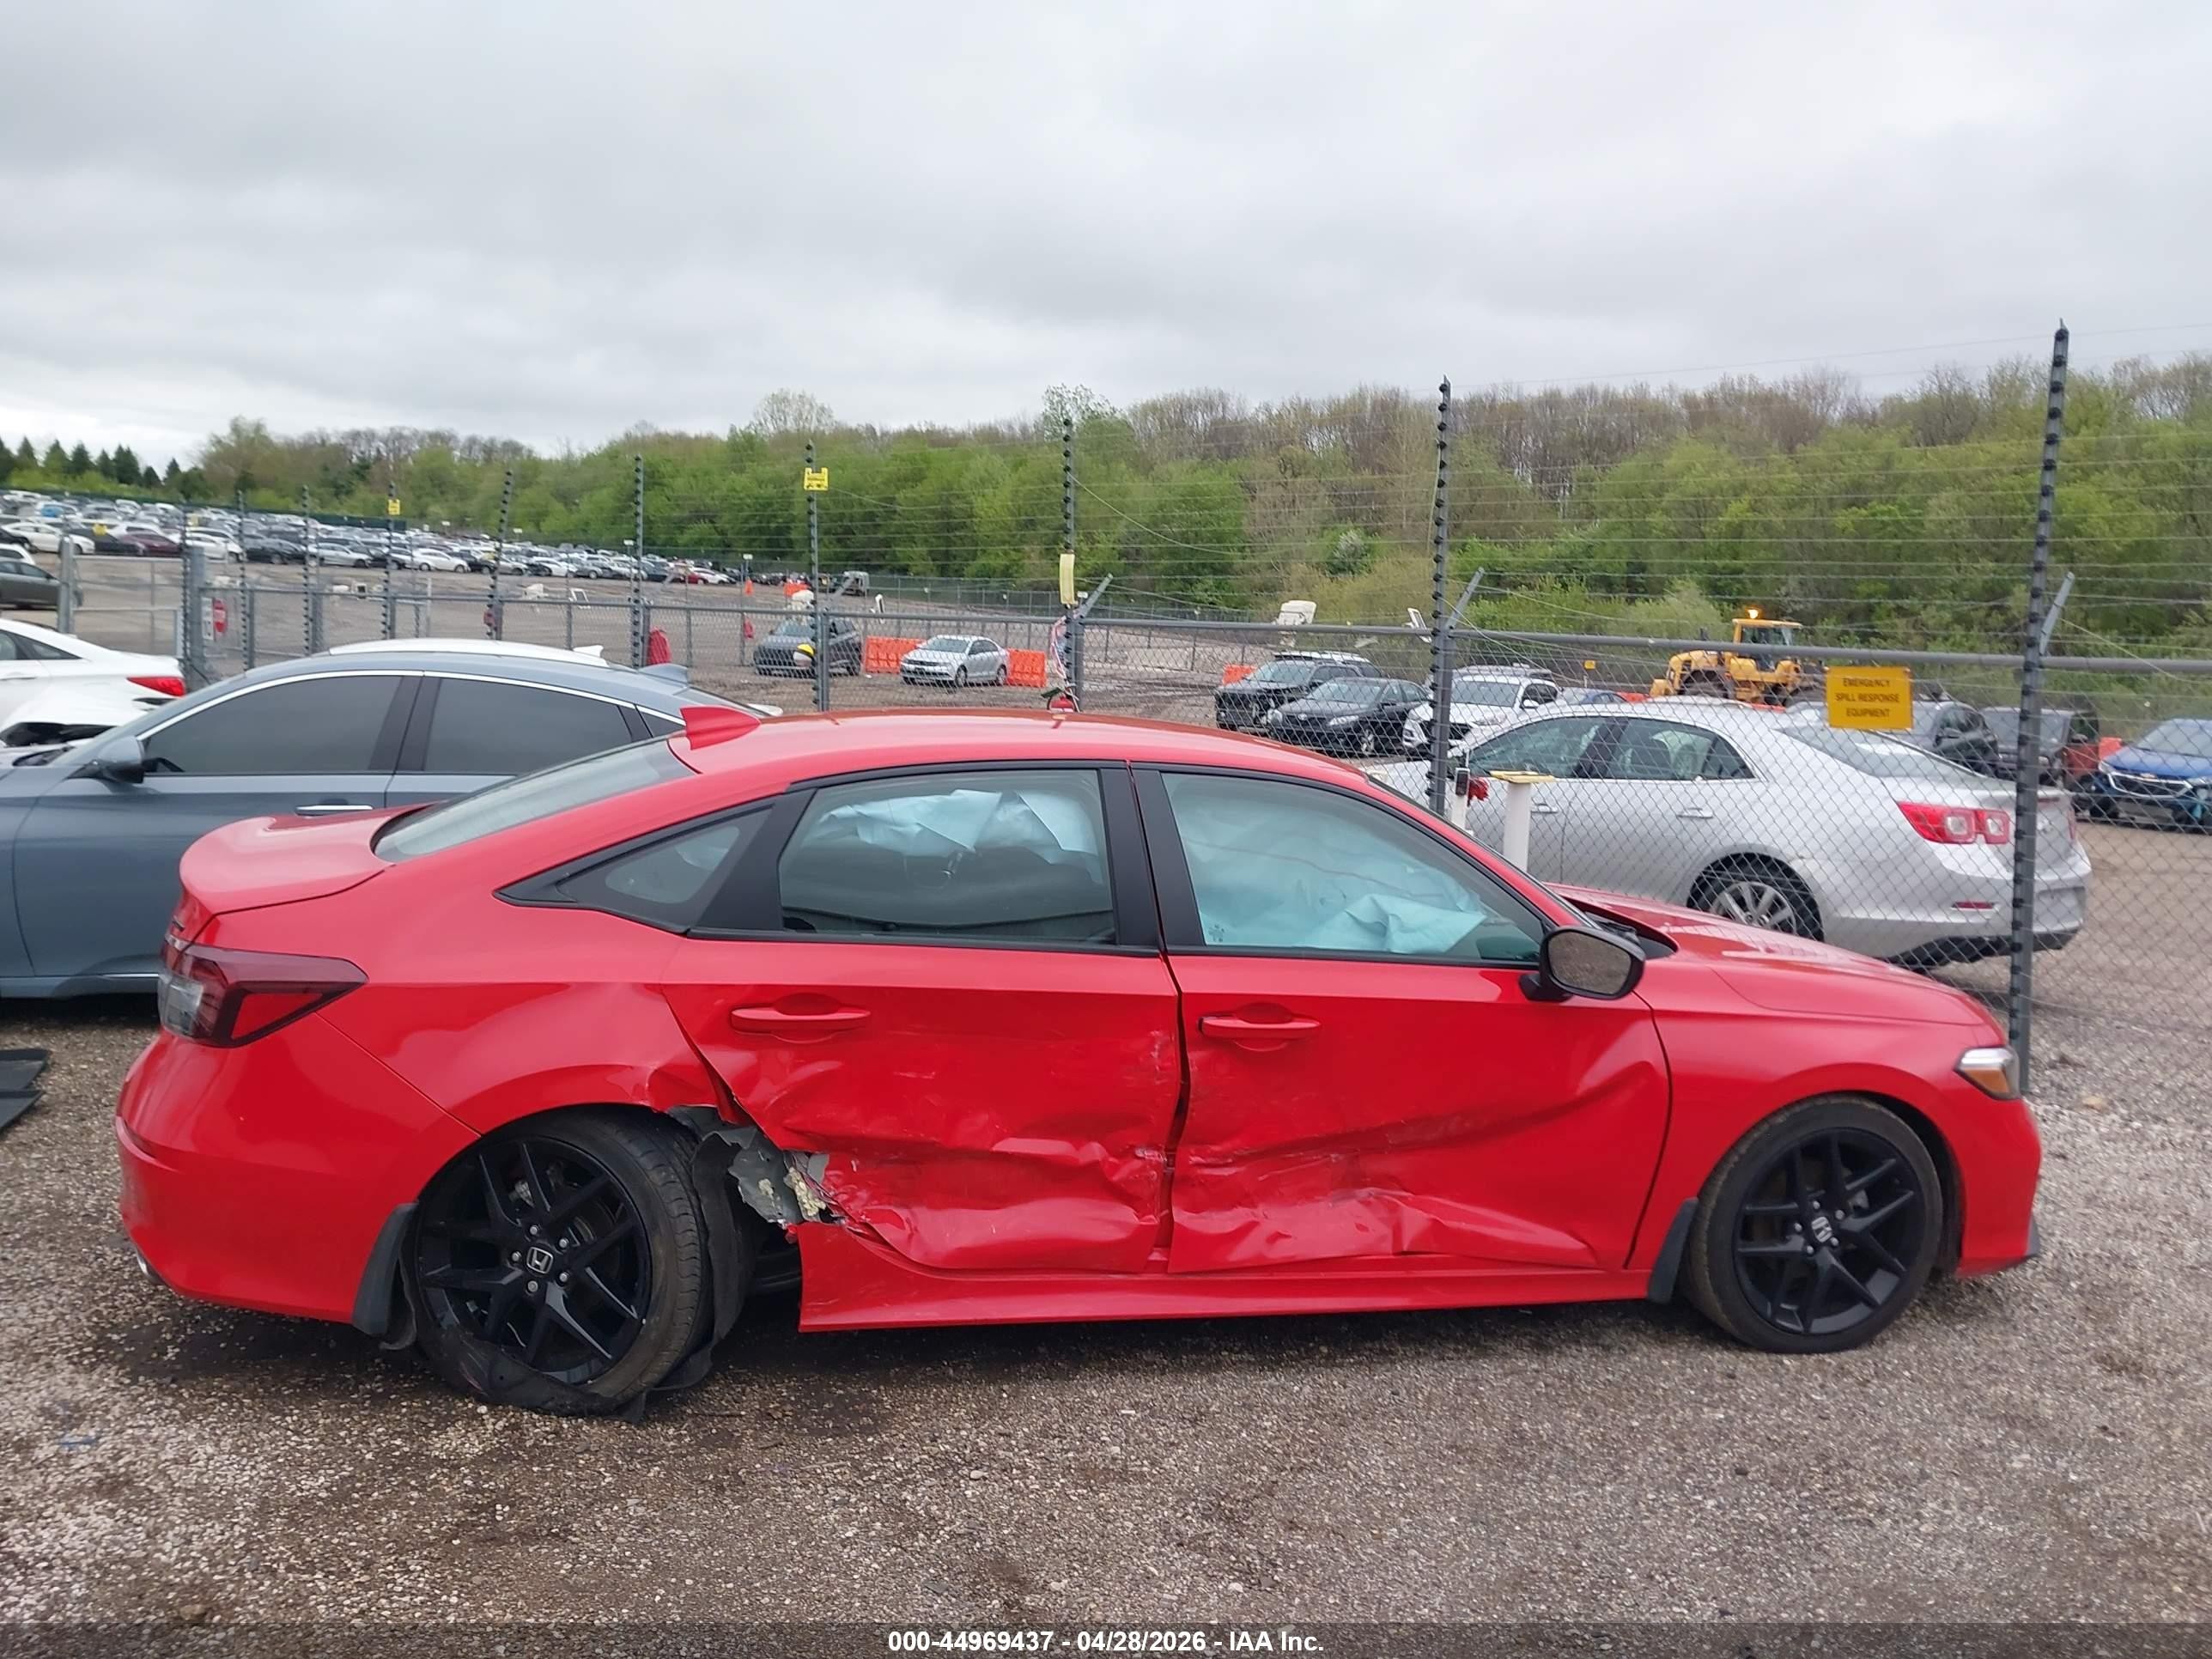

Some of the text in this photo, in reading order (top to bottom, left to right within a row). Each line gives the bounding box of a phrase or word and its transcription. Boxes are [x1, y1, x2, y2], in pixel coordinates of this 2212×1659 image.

[1835, 692, 1900, 703] SPILL RESPONSE
[1845, 708, 1890, 718] EQUIPMENT
